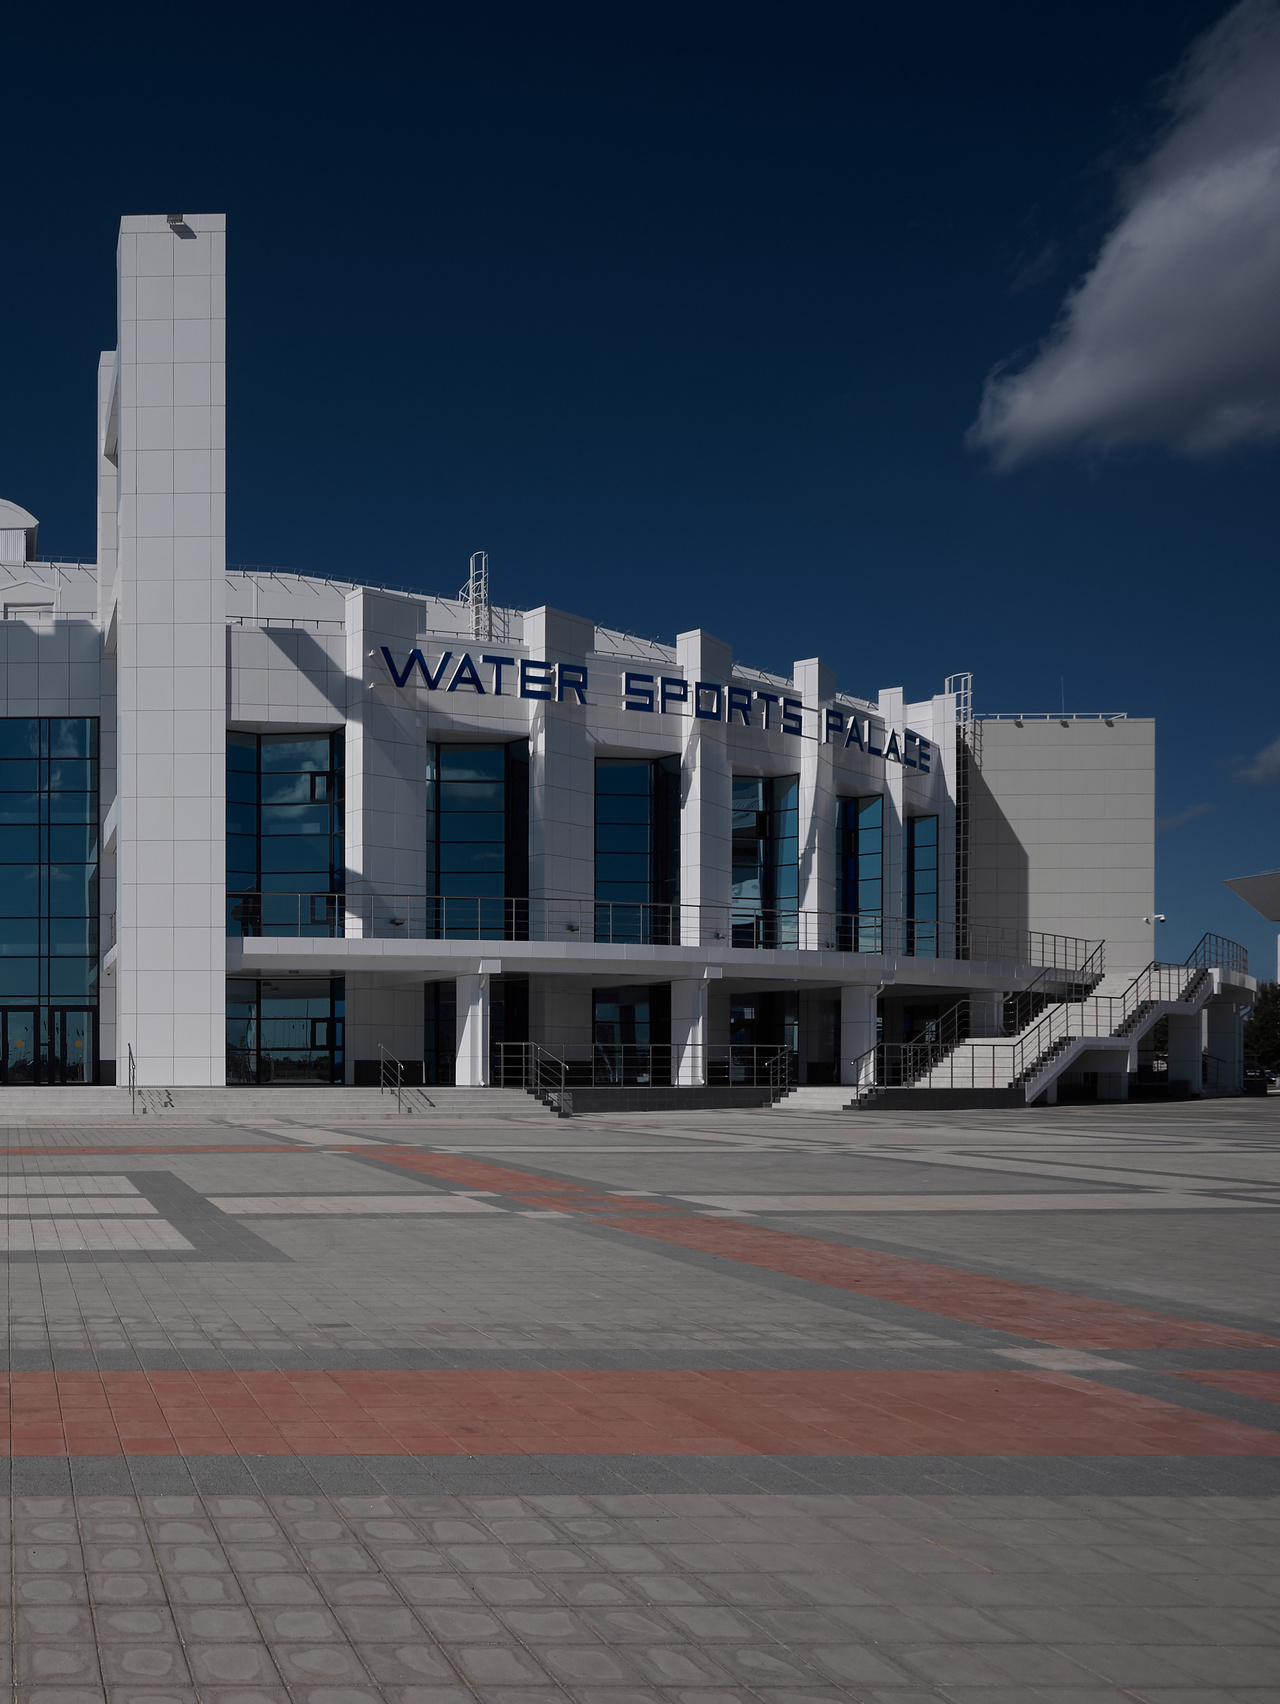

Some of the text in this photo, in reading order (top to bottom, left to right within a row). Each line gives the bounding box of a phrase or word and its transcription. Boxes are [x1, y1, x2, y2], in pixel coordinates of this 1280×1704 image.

[380, 646, 930, 774] WATER SPORTS PALACE
